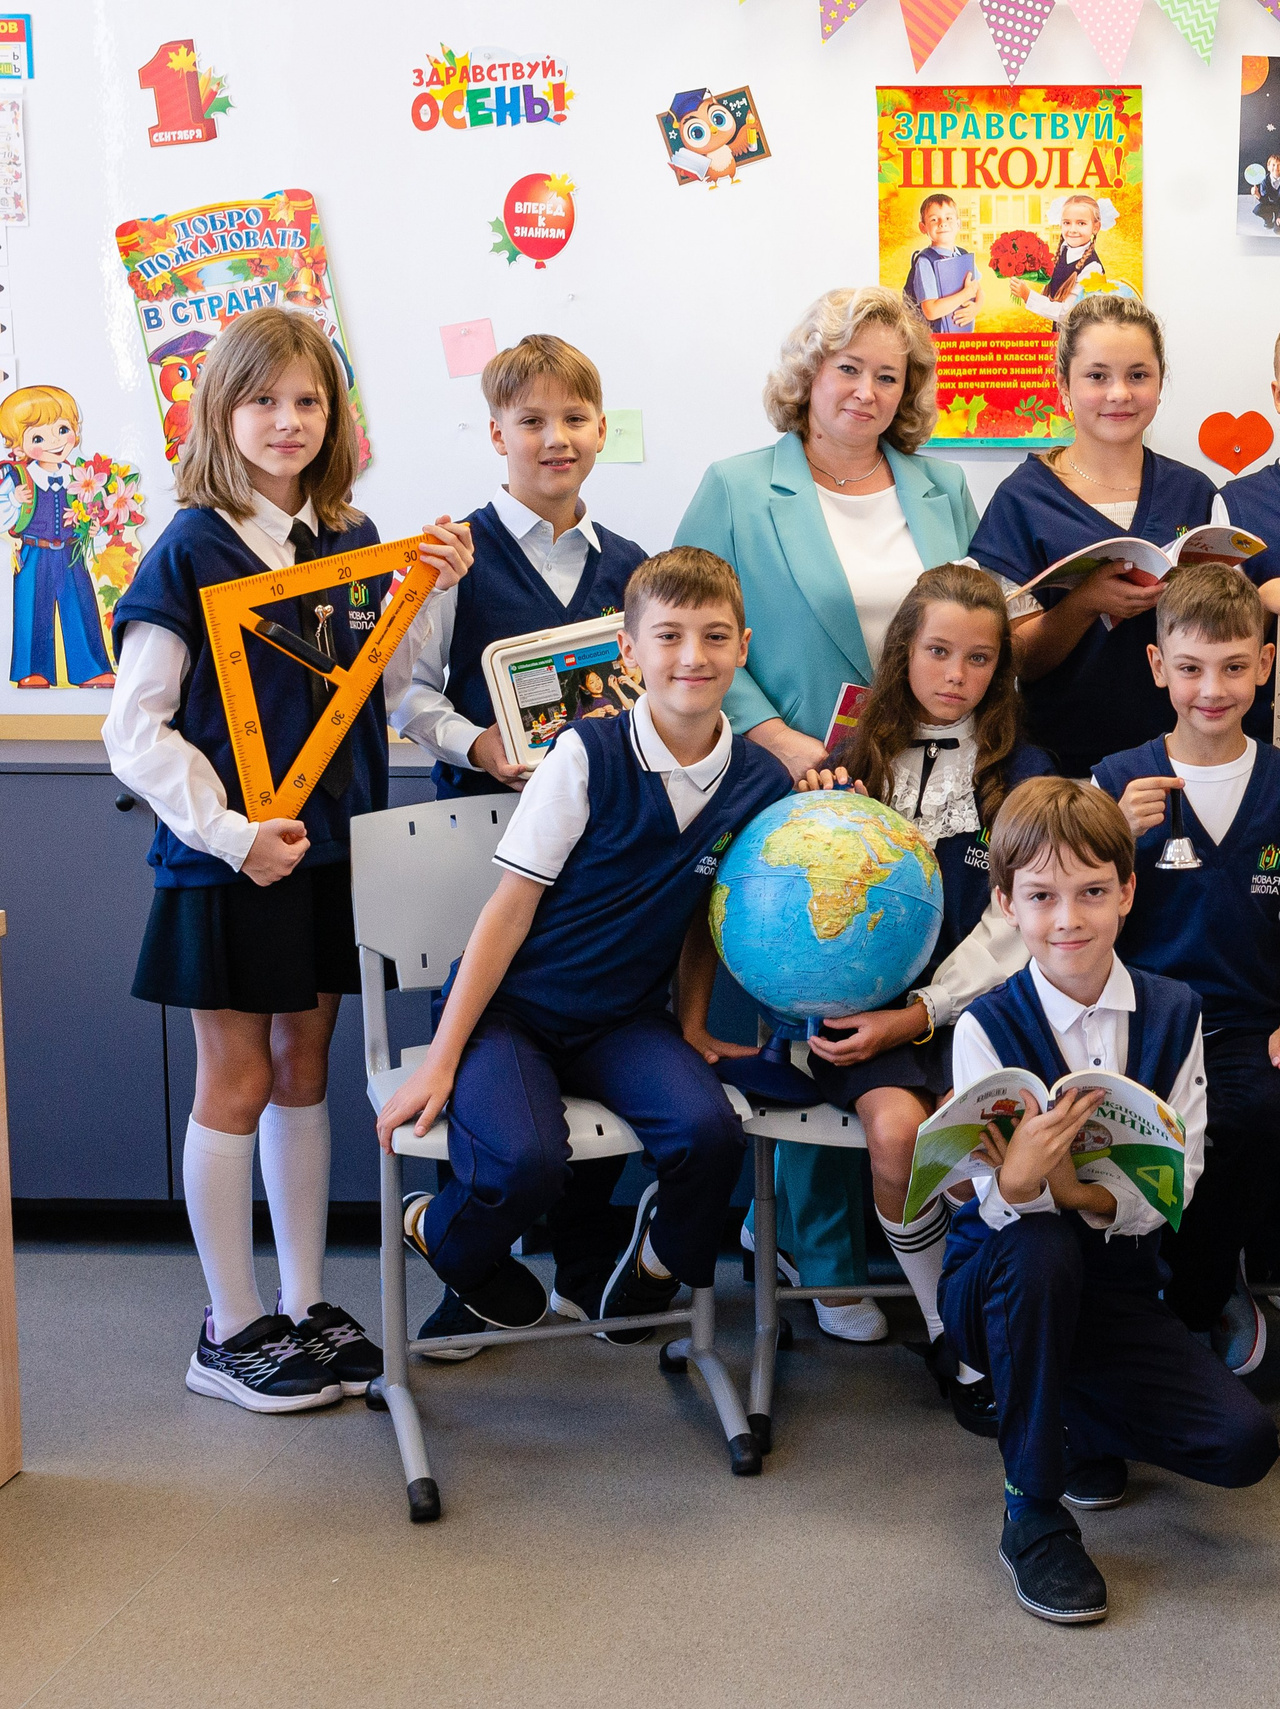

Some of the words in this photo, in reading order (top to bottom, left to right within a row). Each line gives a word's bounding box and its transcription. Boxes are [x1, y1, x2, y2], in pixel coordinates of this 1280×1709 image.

[412, 55, 563, 87] ЗДРАВСТВУЙ,
[411, 82, 567, 131] ОСЕНЬ!
[895, 105, 1126, 145] ЗДРАВСТВУЙ,
[152, 129, 203, 143] СЕНТЯБРЯ
[898, 146, 1126, 189] ШКОЛА!
[514, 201, 565, 217] ВПЕРЕД
[173, 207, 262, 243] ДОБРО
[537, 215, 546, 227] К
[514, 226, 566, 239] ЗНАНИЯМ
[135, 228, 306, 281] ПОЖАЛОВАТЬ
[143, 306, 163, 330] В
[171, 282, 279, 324] СТРАНУ
[959, 340, 988, 350] двери
[989, 340, 1040, 350] открывает
[954, 352, 994, 362] веселый
[937, 367, 977, 376] ожидает
[979, 367, 1008, 375] много
[1009, 365, 1043, 375] знаний
[958, 380, 1018, 389] впечатлений
[1020, 379, 1051, 389] целый
[270, 583, 284, 596] 10
[337, 566, 352, 580] 20
[404, 550, 418, 563] 30
[404, 588, 418, 603] 10
[348, 610, 376, 620] НОВАЯ
[349, 620, 376, 630] ШКОЛА
[368, 647, 382, 663] 20
[577, 650, 610, 661] education
[331, 710, 345, 726] 30
[229, 650, 242, 665] 10
[244, 720, 258, 736] 20
[259, 791, 272, 806] 30
[293, 773, 307, 789] 40
[966, 846, 990, 860] НОВ
[964, 855, 990, 871] ШКО
[1252, 874, 1280, 886] НОВАЯ
[1251, 884, 1279, 895] ШКОЛА
[1095, 1106, 1152, 1138] МИР
[1137, 1165, 1178, 1207] 4
